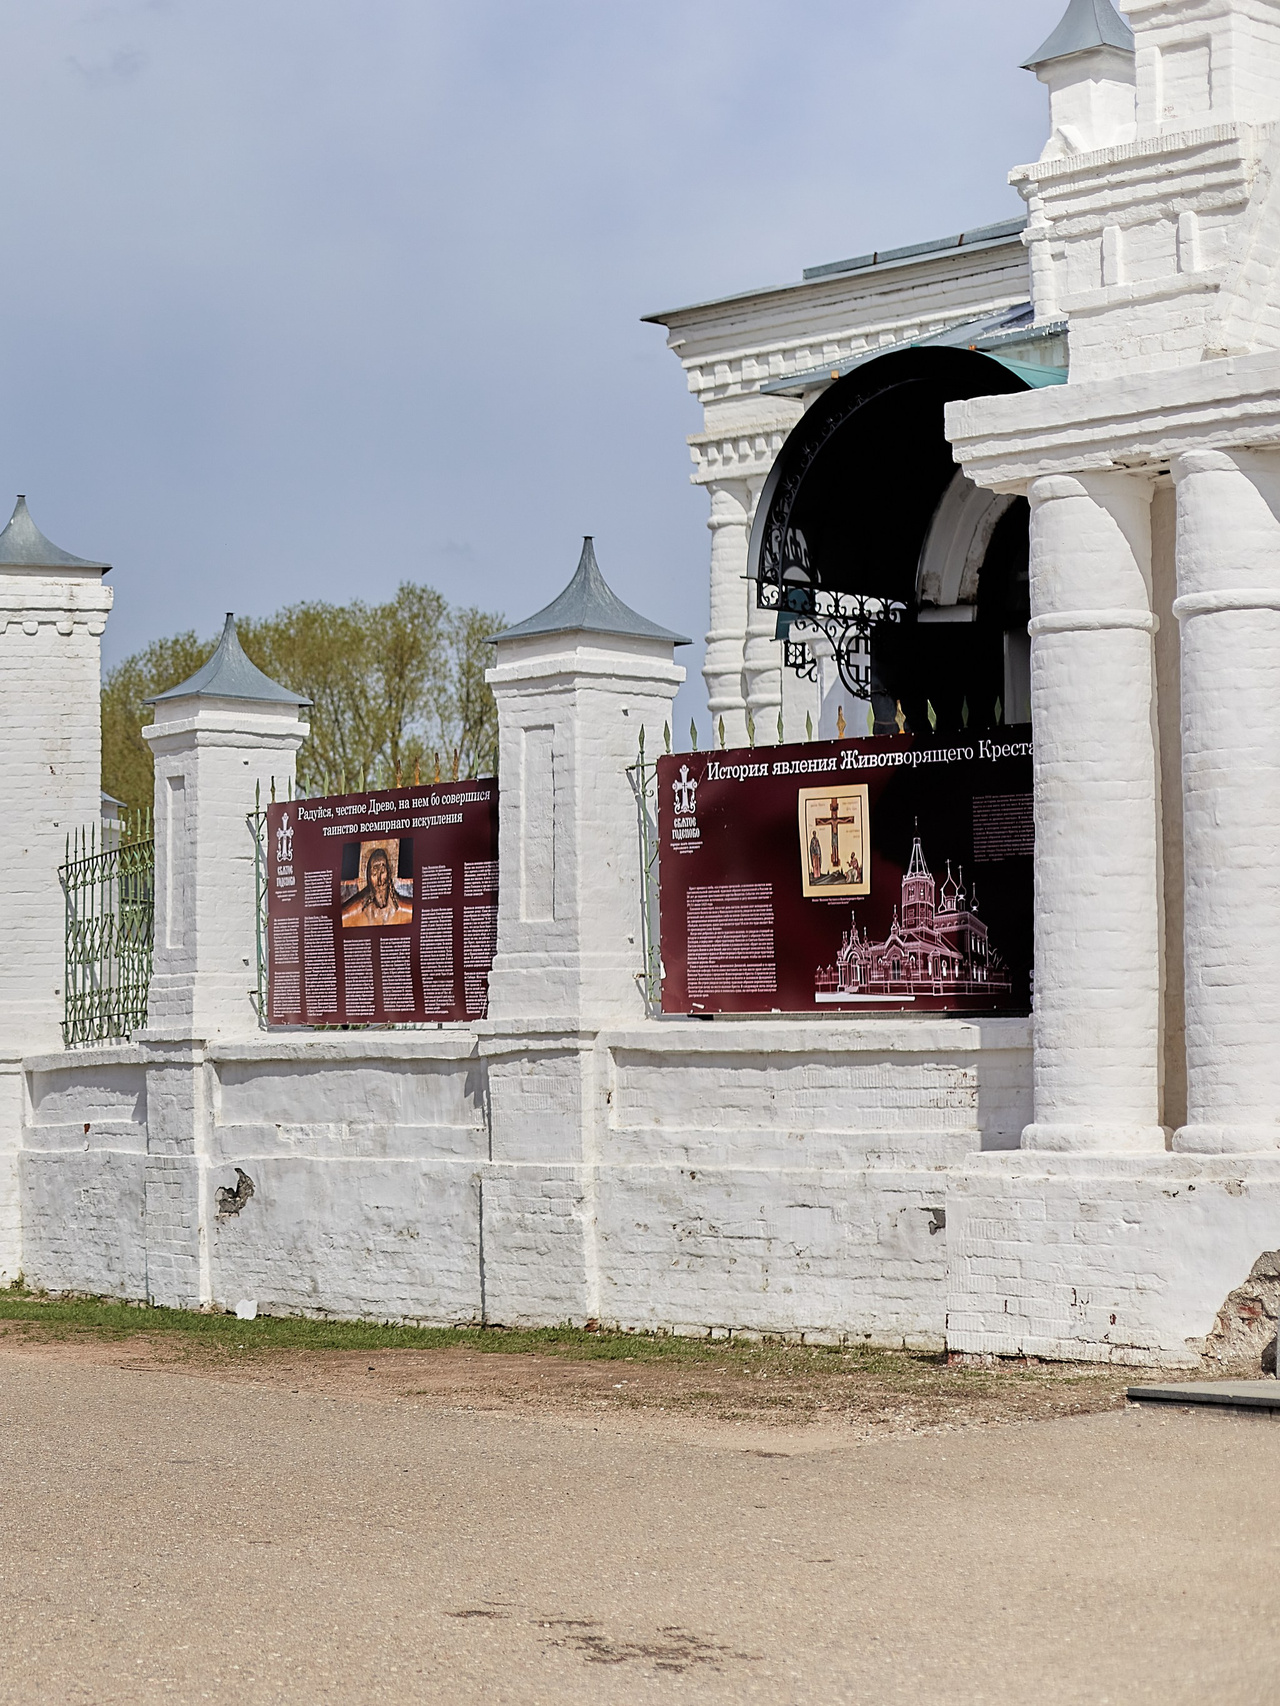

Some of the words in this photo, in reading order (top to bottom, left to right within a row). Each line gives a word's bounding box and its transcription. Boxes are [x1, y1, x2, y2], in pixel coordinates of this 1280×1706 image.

[707, 762, 769, 782] История
[772, 758, 837, 775] явления
[840, 746, 974, 769] Животворящего
[297, 806, 334, 822] Радуйся,
[335, 804, 367, 817] честное
[367, 799, 397, 815] Древо,
[398, 799, 410, 810] на
[411, 797, 429, 809] нем
[430, 793, 441, 806] бо
[441, 790, 490, 805] совершися
[322, 823, 359, 836] таинство
[360, 817, 411, 834] всемирнаго
[411, 812, 463, 828] искупления
